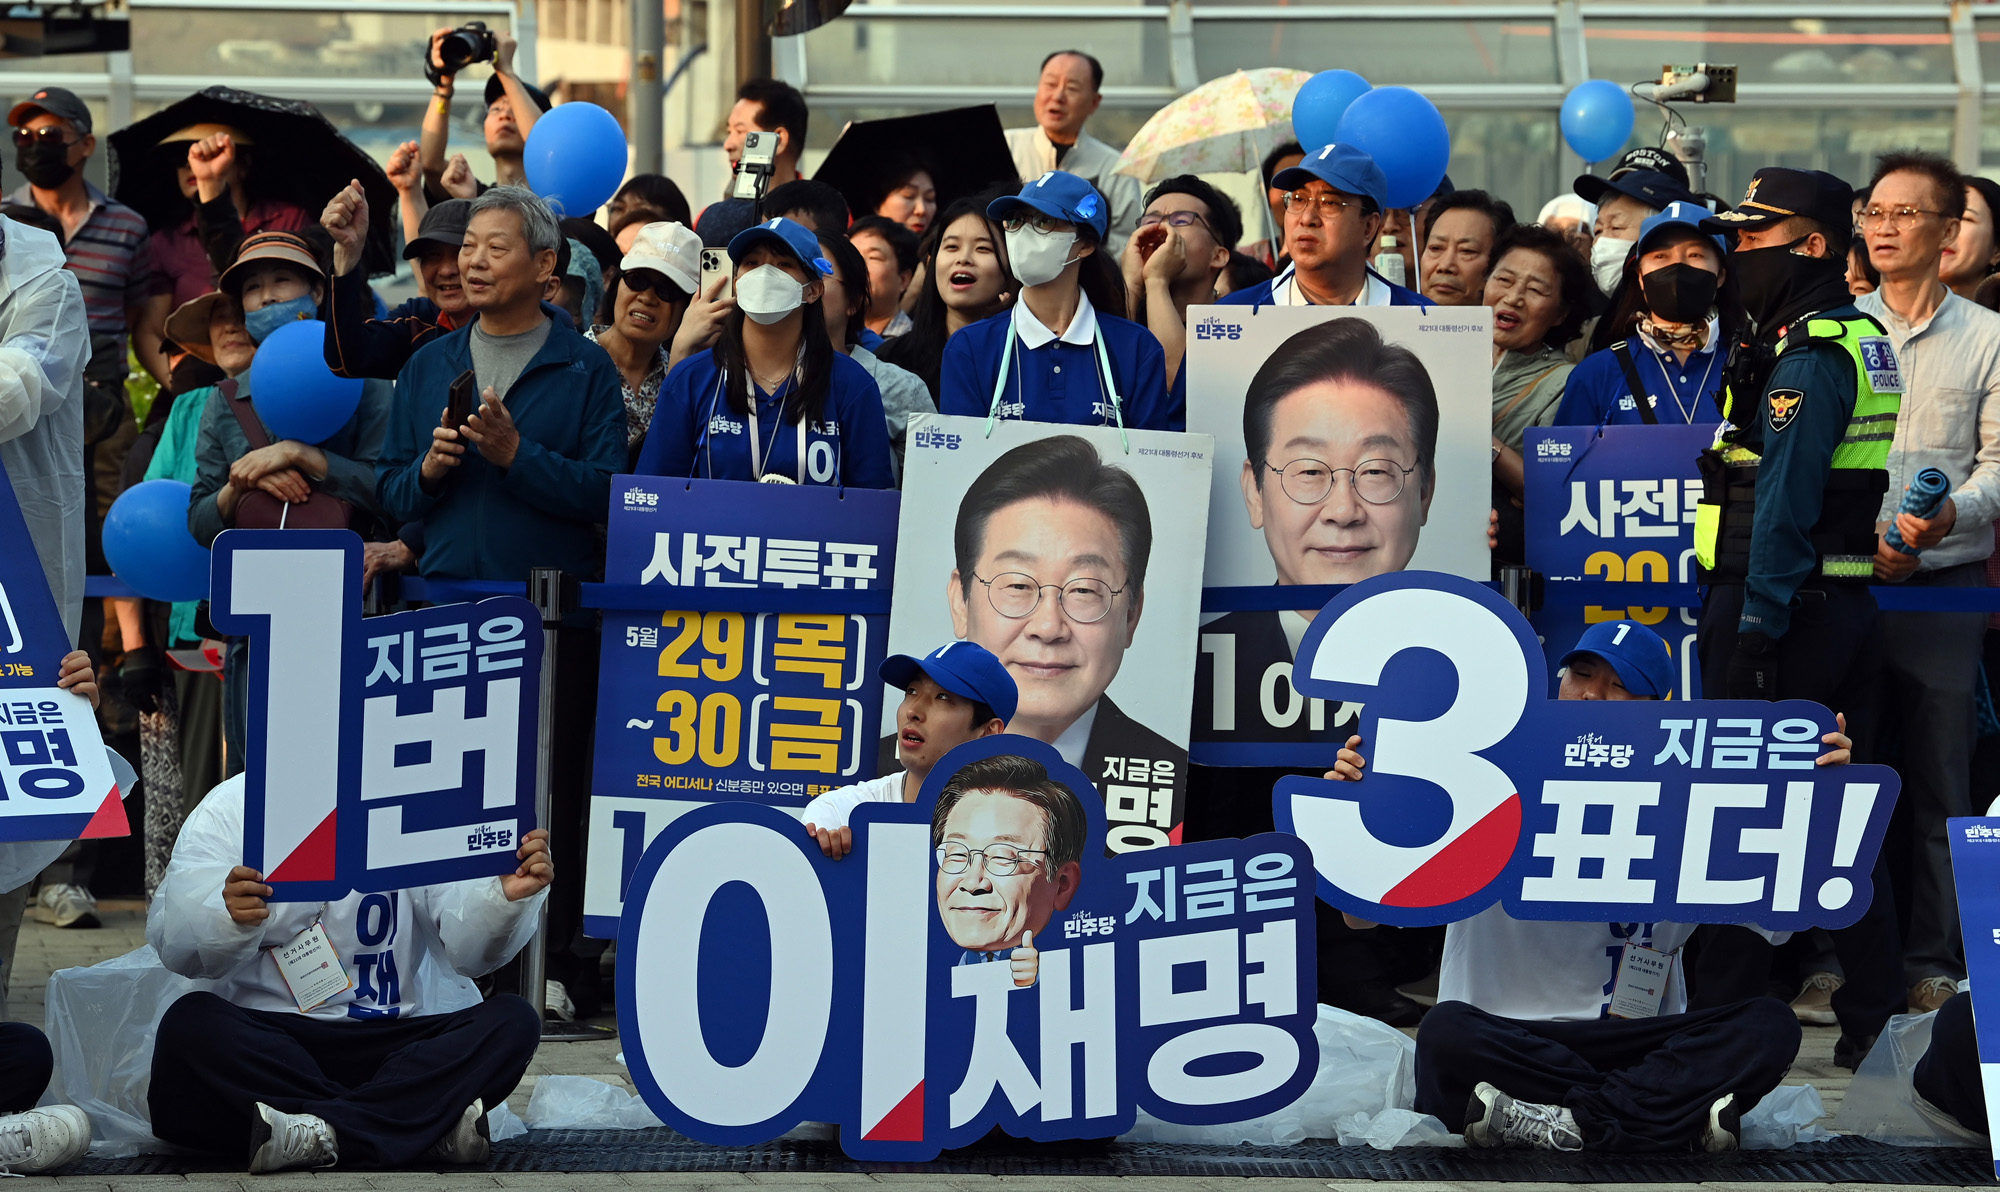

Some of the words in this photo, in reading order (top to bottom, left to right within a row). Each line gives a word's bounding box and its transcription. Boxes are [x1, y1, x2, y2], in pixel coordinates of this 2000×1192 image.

[1318, 144, 1336, 160] 1
[1625, 149, 1671, 167] BOSTON
[1036, 171, 1055, 188] 1
[1668, 202, 1681, 218] 1
[769, 217, 783, 230] 1
[1195, 324, 1242, 340] 민주당
[1439, 325, 1470, 333] 대통령선거
[1471, 325, 1484, 333] 후보
[1872, 374, 1900, 387] POLICE
[1619, 395, 1658, 411] 민당
[710, 420, 743, 435] 민주당
[915, 432, 962, 450] 민주당
[1537, 443, 1572, 456] 민주당
[1138, 448, 1157, 456] 제21대
[1158, 449, 1190, 459] 대통령선거
[624, 492, 659, 506] 민주당
[641, 532, 878, 590] 사전투표
[626, 626, 658, 649] 5월
[1612, 623, 1631, 646] 1
[365, 616, 527, 687] 지금은
[7, 664, 34, 676] 가능
[1564, 743, 1635, 769] 민주당
[1653, 718, 1820, 769] 지금은
[1577, 732, 1603, 745] 더불어
[1, 728, 85, 799] 명
[1102, 756, 1176, 785] 지금은
[636, 774, 661, 788] 전국
[664, 776, 713, 791] 어디서나
[715, 779, 765, 794] 신분증만
[767, 782, 804, 796] 있으면
[467, 829, 513, 852] 민주당
[1124, 852, 1297, 925] 지금은
[1064, 916, 1117, 939] 민주당
